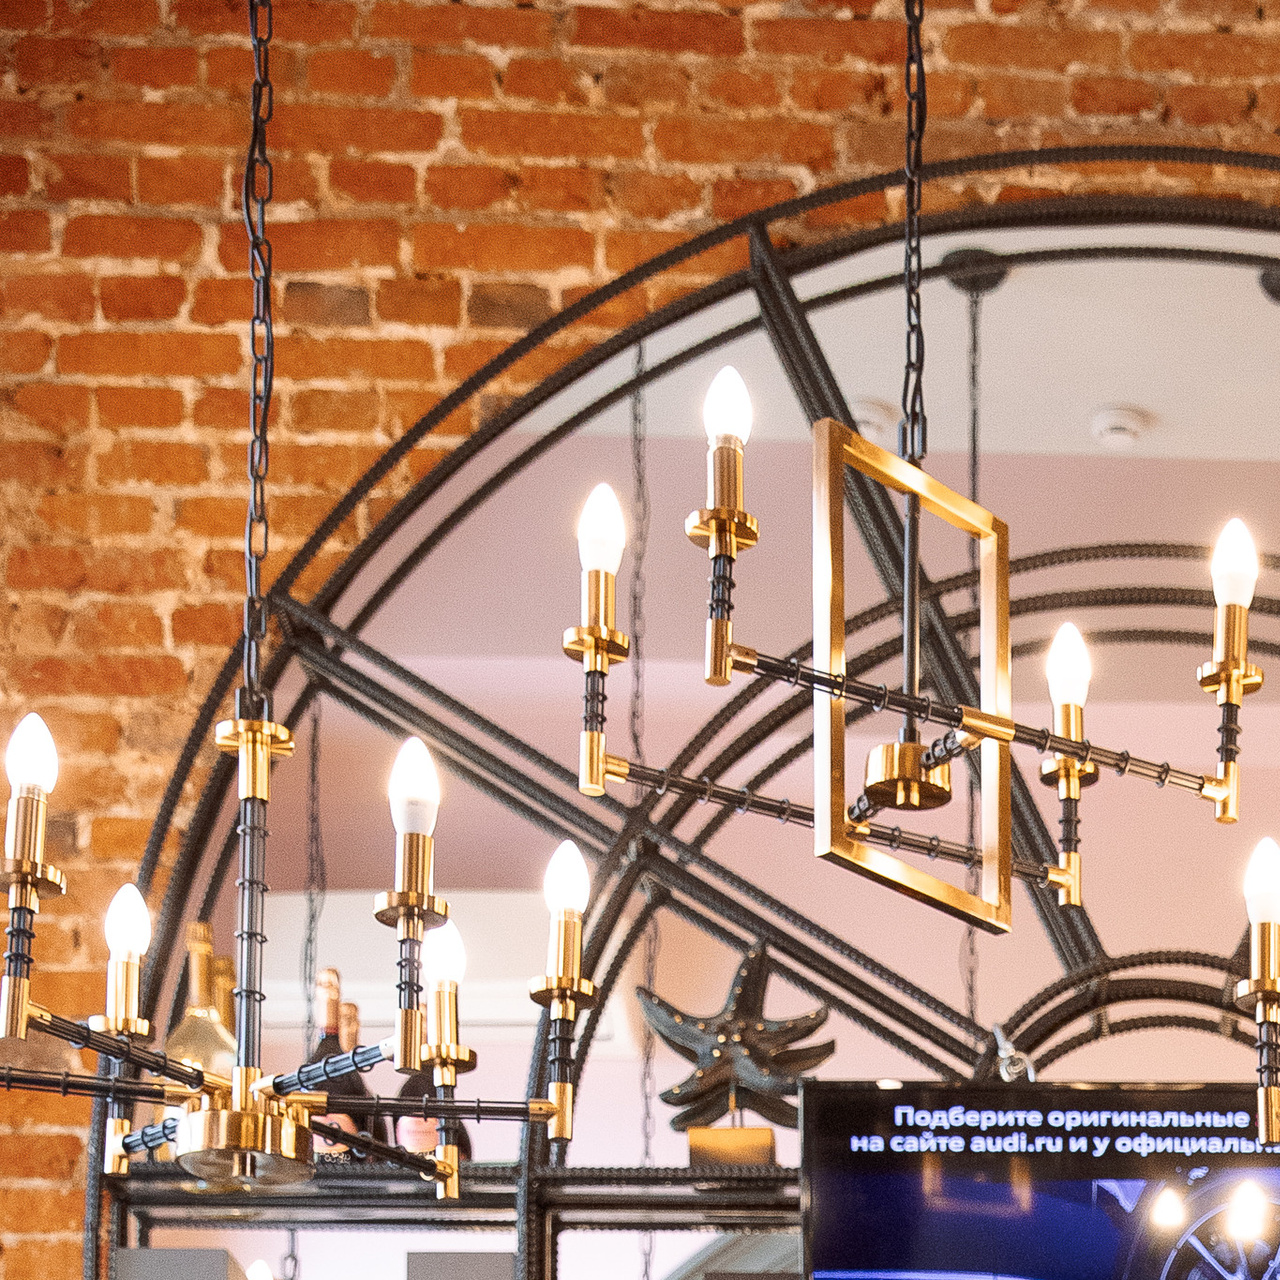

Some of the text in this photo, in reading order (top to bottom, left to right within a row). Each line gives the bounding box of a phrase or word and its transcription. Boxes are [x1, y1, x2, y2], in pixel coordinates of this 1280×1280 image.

[893, 1105, 1250, 1131] Подберите оригинальные
[850, 1135, 885, 1153] на
[889, 1131, 965, 1153] сайте
[970, 1132, 1063, 1153] audi.ru
[1068, 1136, 1088, 1153] и
[1092, 1136, 1111, 1157] у
